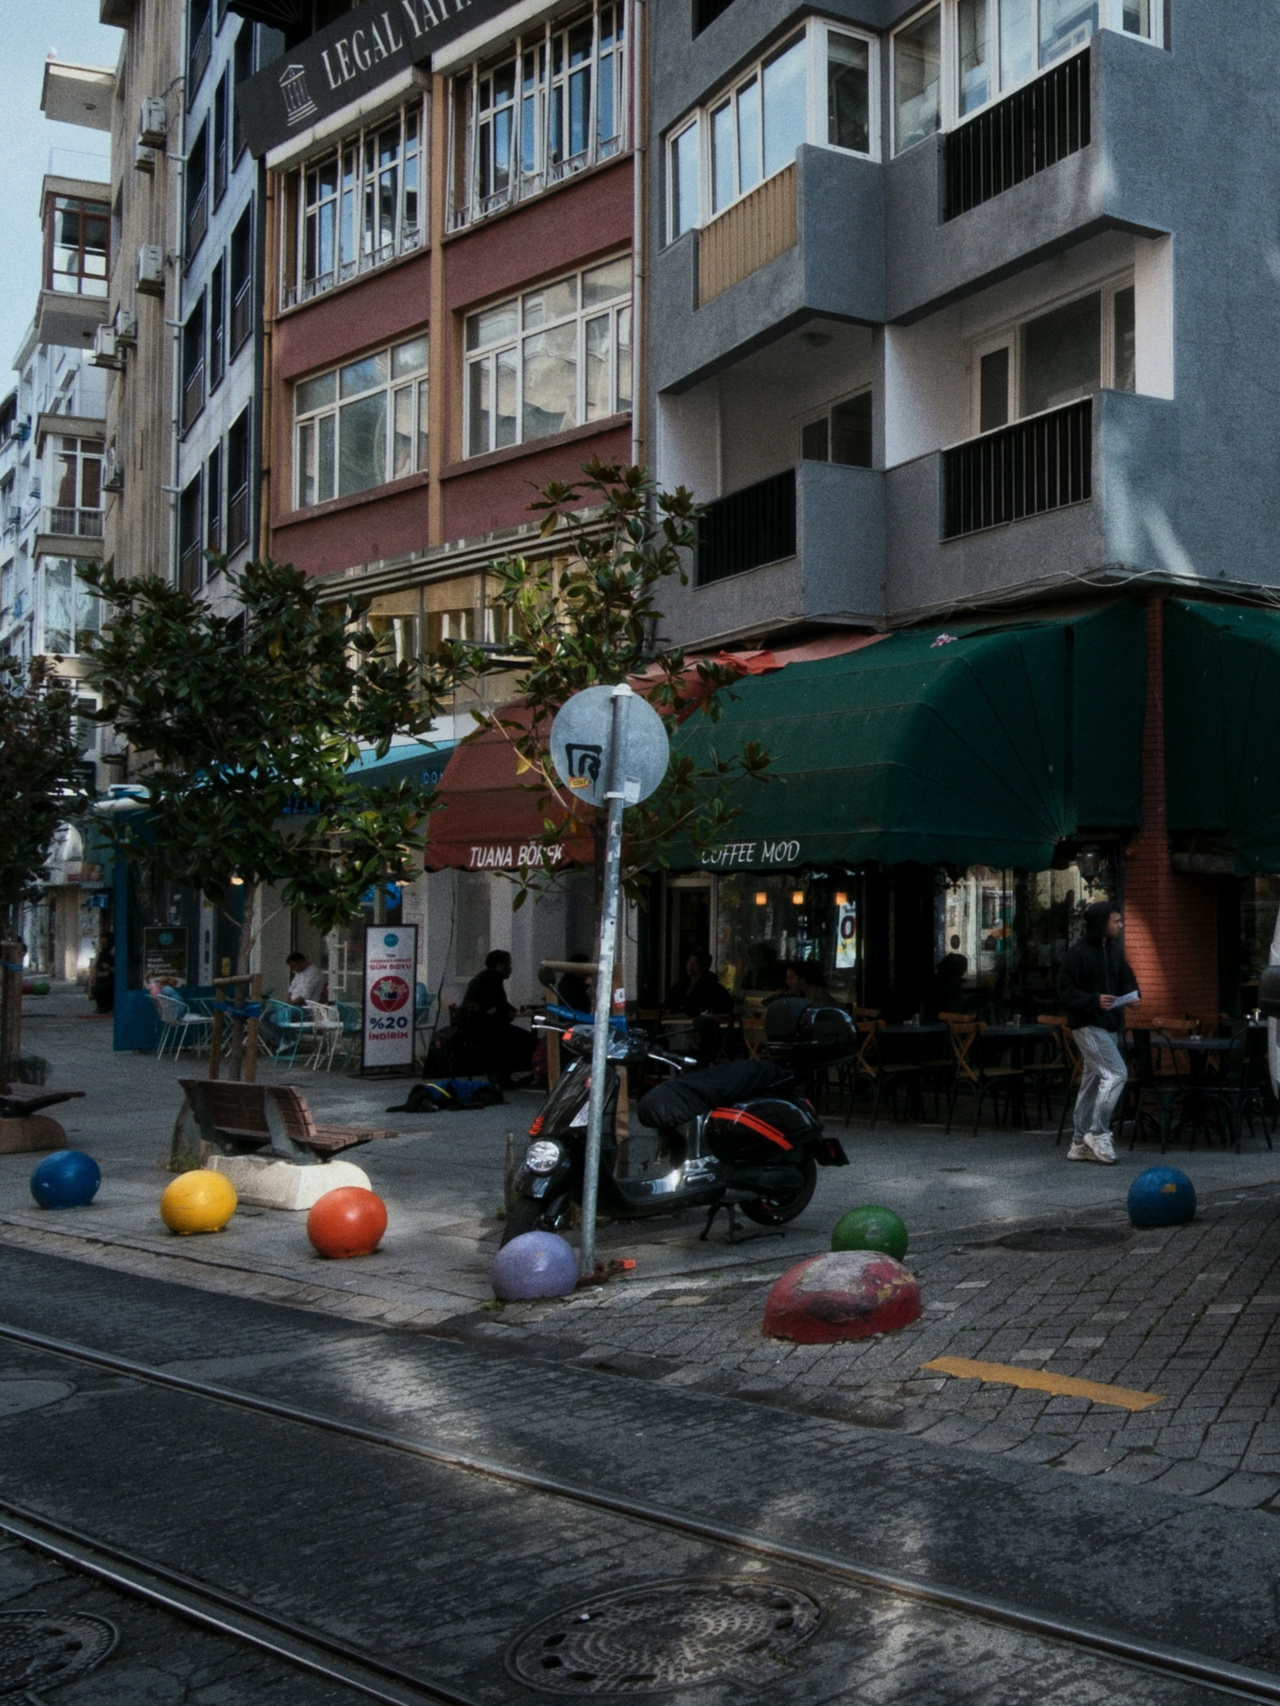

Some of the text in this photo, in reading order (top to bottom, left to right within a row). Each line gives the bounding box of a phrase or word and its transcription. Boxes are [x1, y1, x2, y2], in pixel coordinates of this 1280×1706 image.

[321, 11, 403, 90] LEGAL
[470, 845, 513, 867] TUANA
[761, 840, 800, 863] MOD
[370, 963, 412, 971] GÜN BOYU
[370, 1016, 408, 1029] %20
[369, 1032, 408, 1041] İNDİRİM
